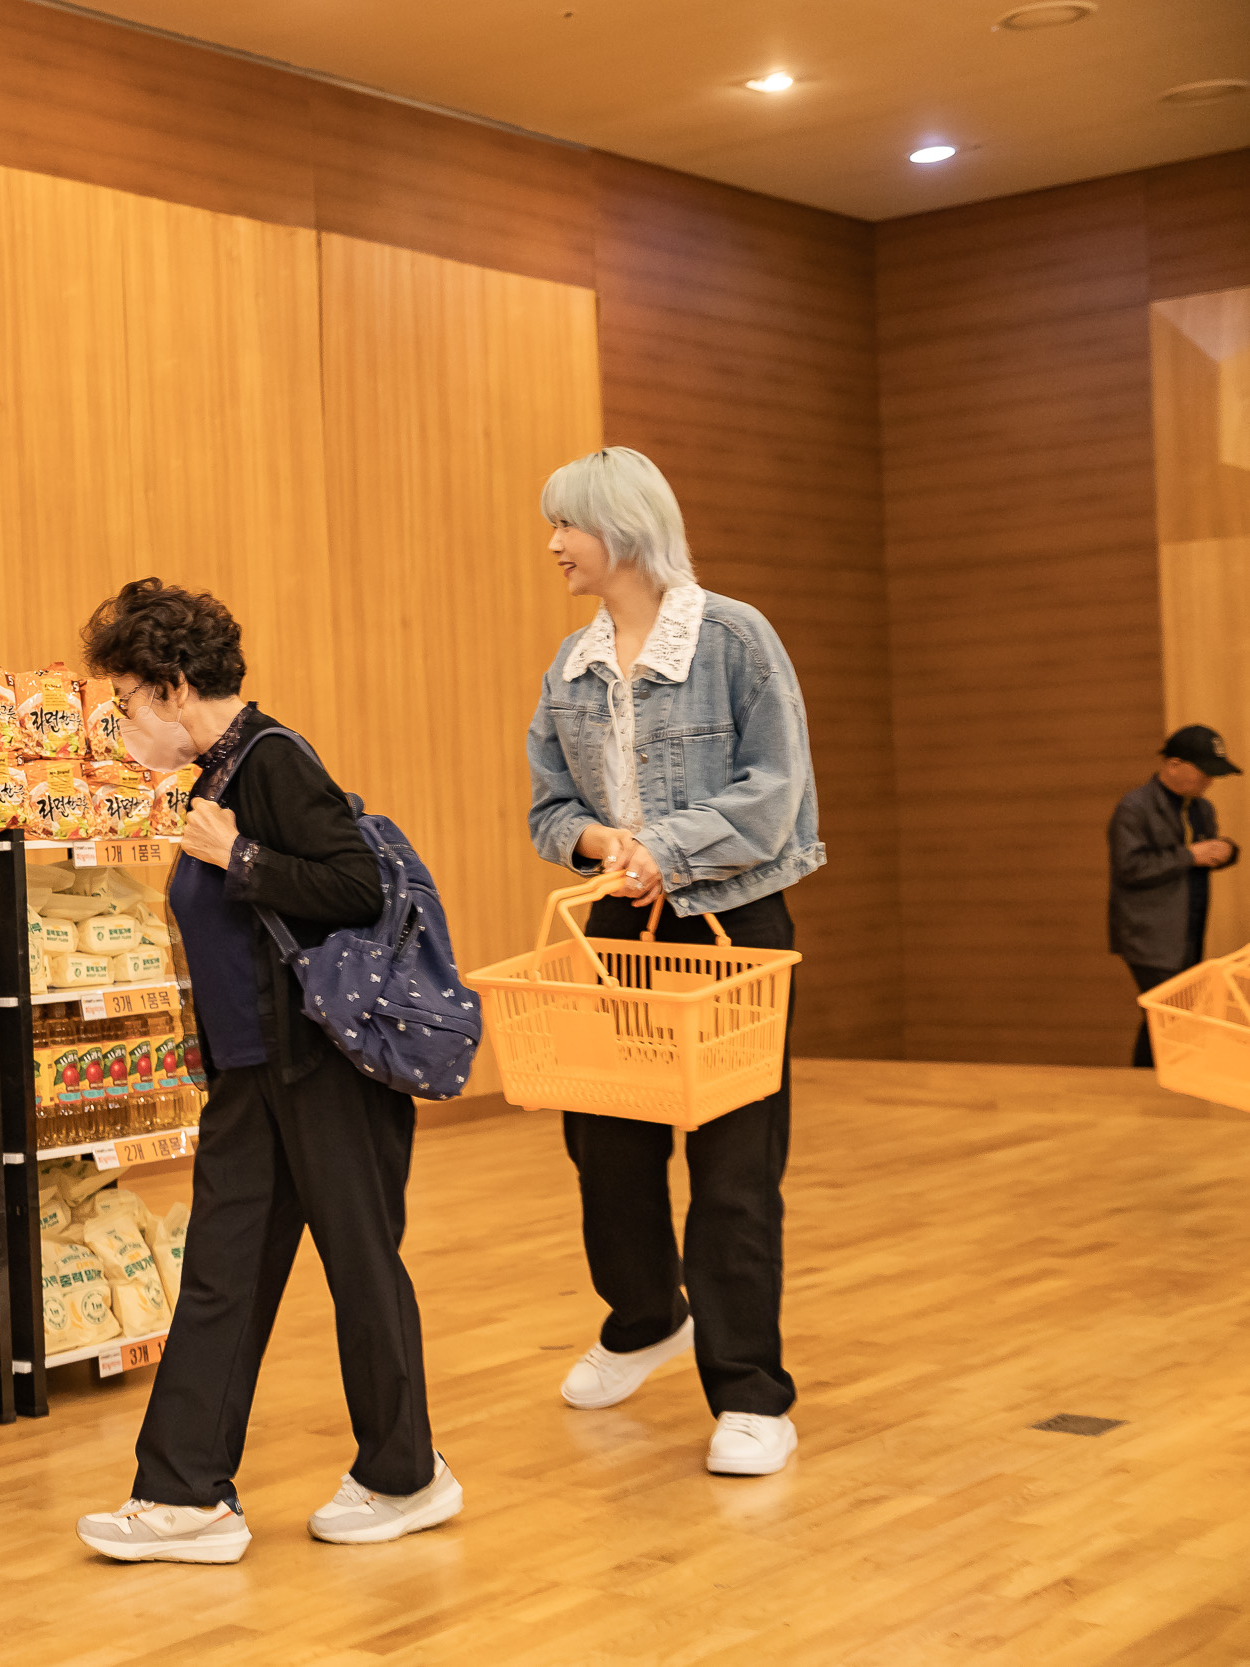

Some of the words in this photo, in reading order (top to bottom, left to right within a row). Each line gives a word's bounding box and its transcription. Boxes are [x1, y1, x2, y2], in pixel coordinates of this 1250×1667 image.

[105, 845, 123, 863] 1개
[132, 844, 161, 861] 1품목
[112, 995, 133, 1013] 3개
[140, 990, 171, 1010] 1품목
[124, 1143, 145, 1162] 2개
[151, 1137, 181, 1158] 1품목
